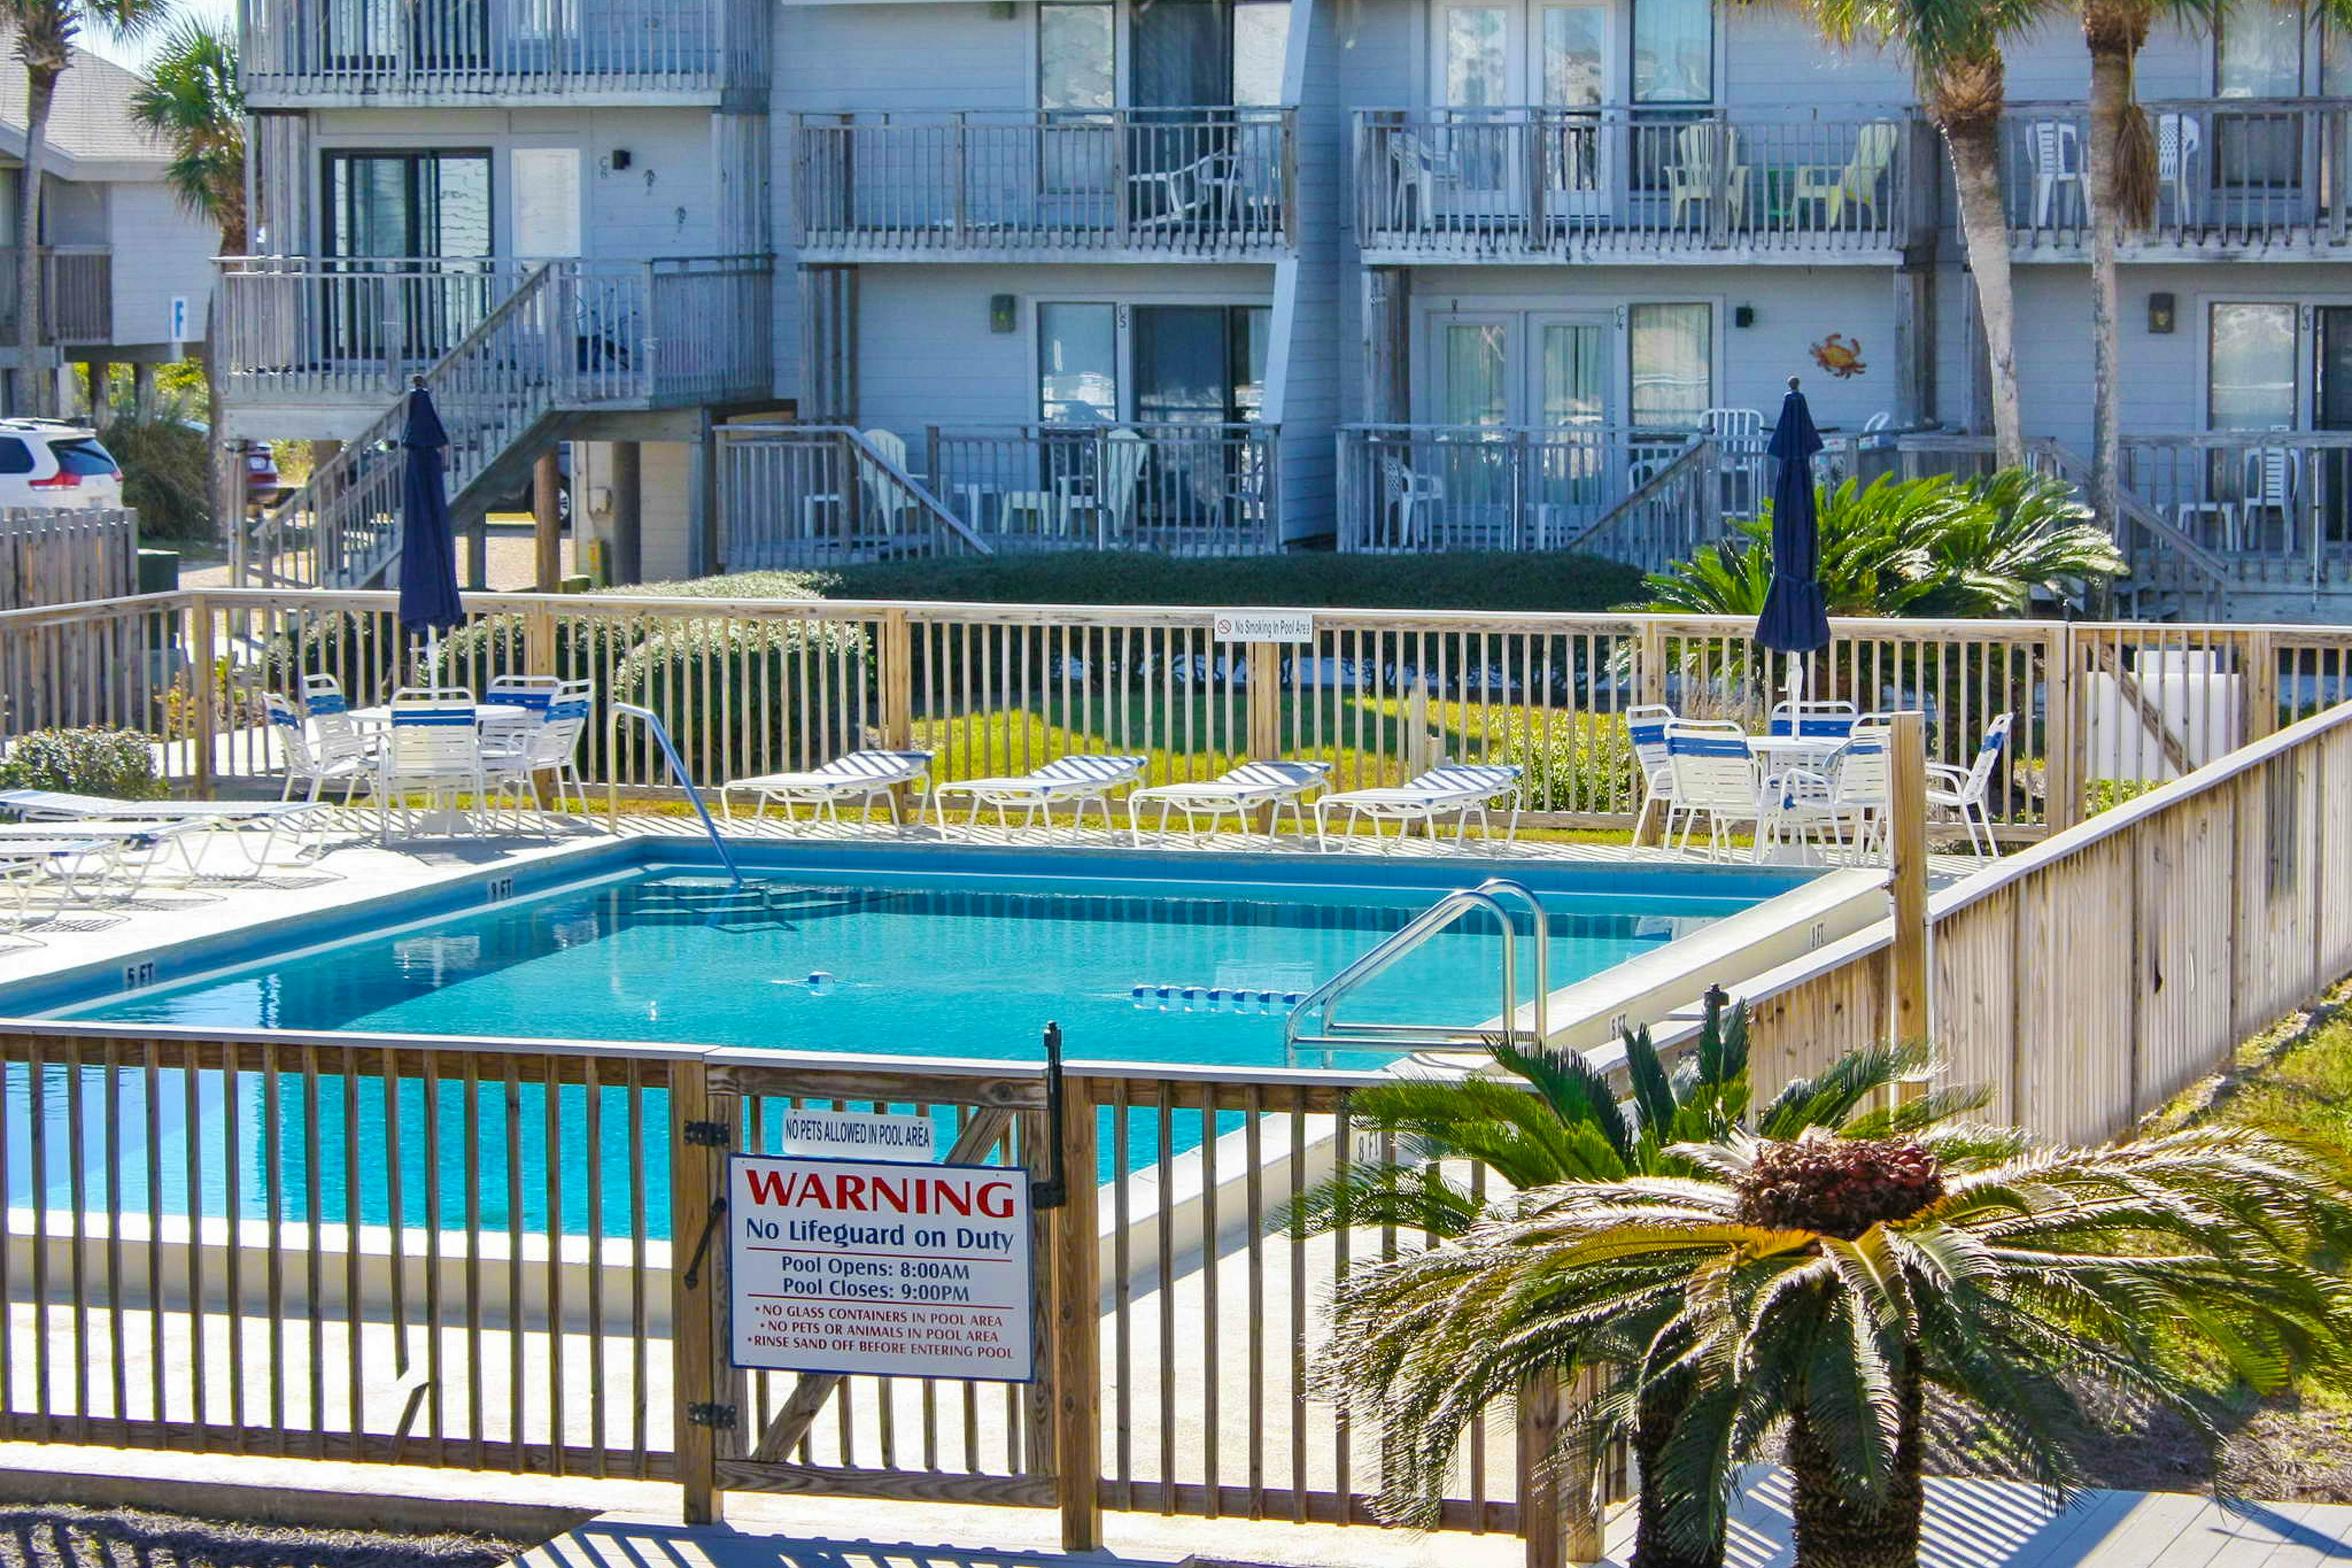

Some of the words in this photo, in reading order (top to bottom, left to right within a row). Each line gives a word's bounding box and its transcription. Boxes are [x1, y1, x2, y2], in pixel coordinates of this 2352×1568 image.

[1236, 620, 1244, 634] No
[1245, 619, 1271, 638] Smoking
[1280, 620, 1295, 634] Pool
[1296, 620, 1310, 634] Area
[128, 968, 134, 988] 5
[140, 963, 153, 986] FT
[786, 1119, 798, 1139] NO
[801, 1120, 822, 1141] PETS
[824, 1121, 867, 1143] ALLOWED
[869, 1124, 877, 1144] IN
[879, 1125, 903, 1146] POOL
[905, 1127, 929, 1148] AREA
[1359, 1136, 1364, 1162] 8
[745, 1169, 1014, 1218] WARNING
[746, 1218, 779, 1240] No
[789, 1220, 905, 1248] Lifeguard
[914, 1229, 946, 1248] on
[957, 1228, 1014, 1253] Duty
[782, 1256, 821, 1272] Pool
[829, 1258, 893, 1277] Opens:
[900, 1262, 970, 1280] 8:00AM
[783, 1278, 822, 1295] Pool
[830, 1279, 894, 1298] Closes:
[902, 1283, 970, 1301] 9:00PM
[763, 1304, 782, 1316] NO
[787, 1306, 824, 1318] GLASS
[829, 1308, 907, 1323] CONTAINERS
[912, 1313, 925, 1323] IN
[931, 1313, 966, 1325] POOL
[970, 1315, 1003, 1327] AREA
[768, 1321, 788, 1332] NO
[792, 1322, 820, 1334] PETS
[824, 1323, 842, 1335] OR
[847, 1325, 903, 1338] ANIMALS
[908, 1328, 922, 1338] IN
[926, 1329, 962, 1341] POOL
[967, 1330, 999, 1342] AREA
[793, 1337, 827, 1350] SAND
[832, 1339, 853, 1351] OFF
[859, 1341, 905, 1354] BEFORE
[911, 1344, 973, 1357] ENTERING
[978, 1347, 1013, 1359] POOL
